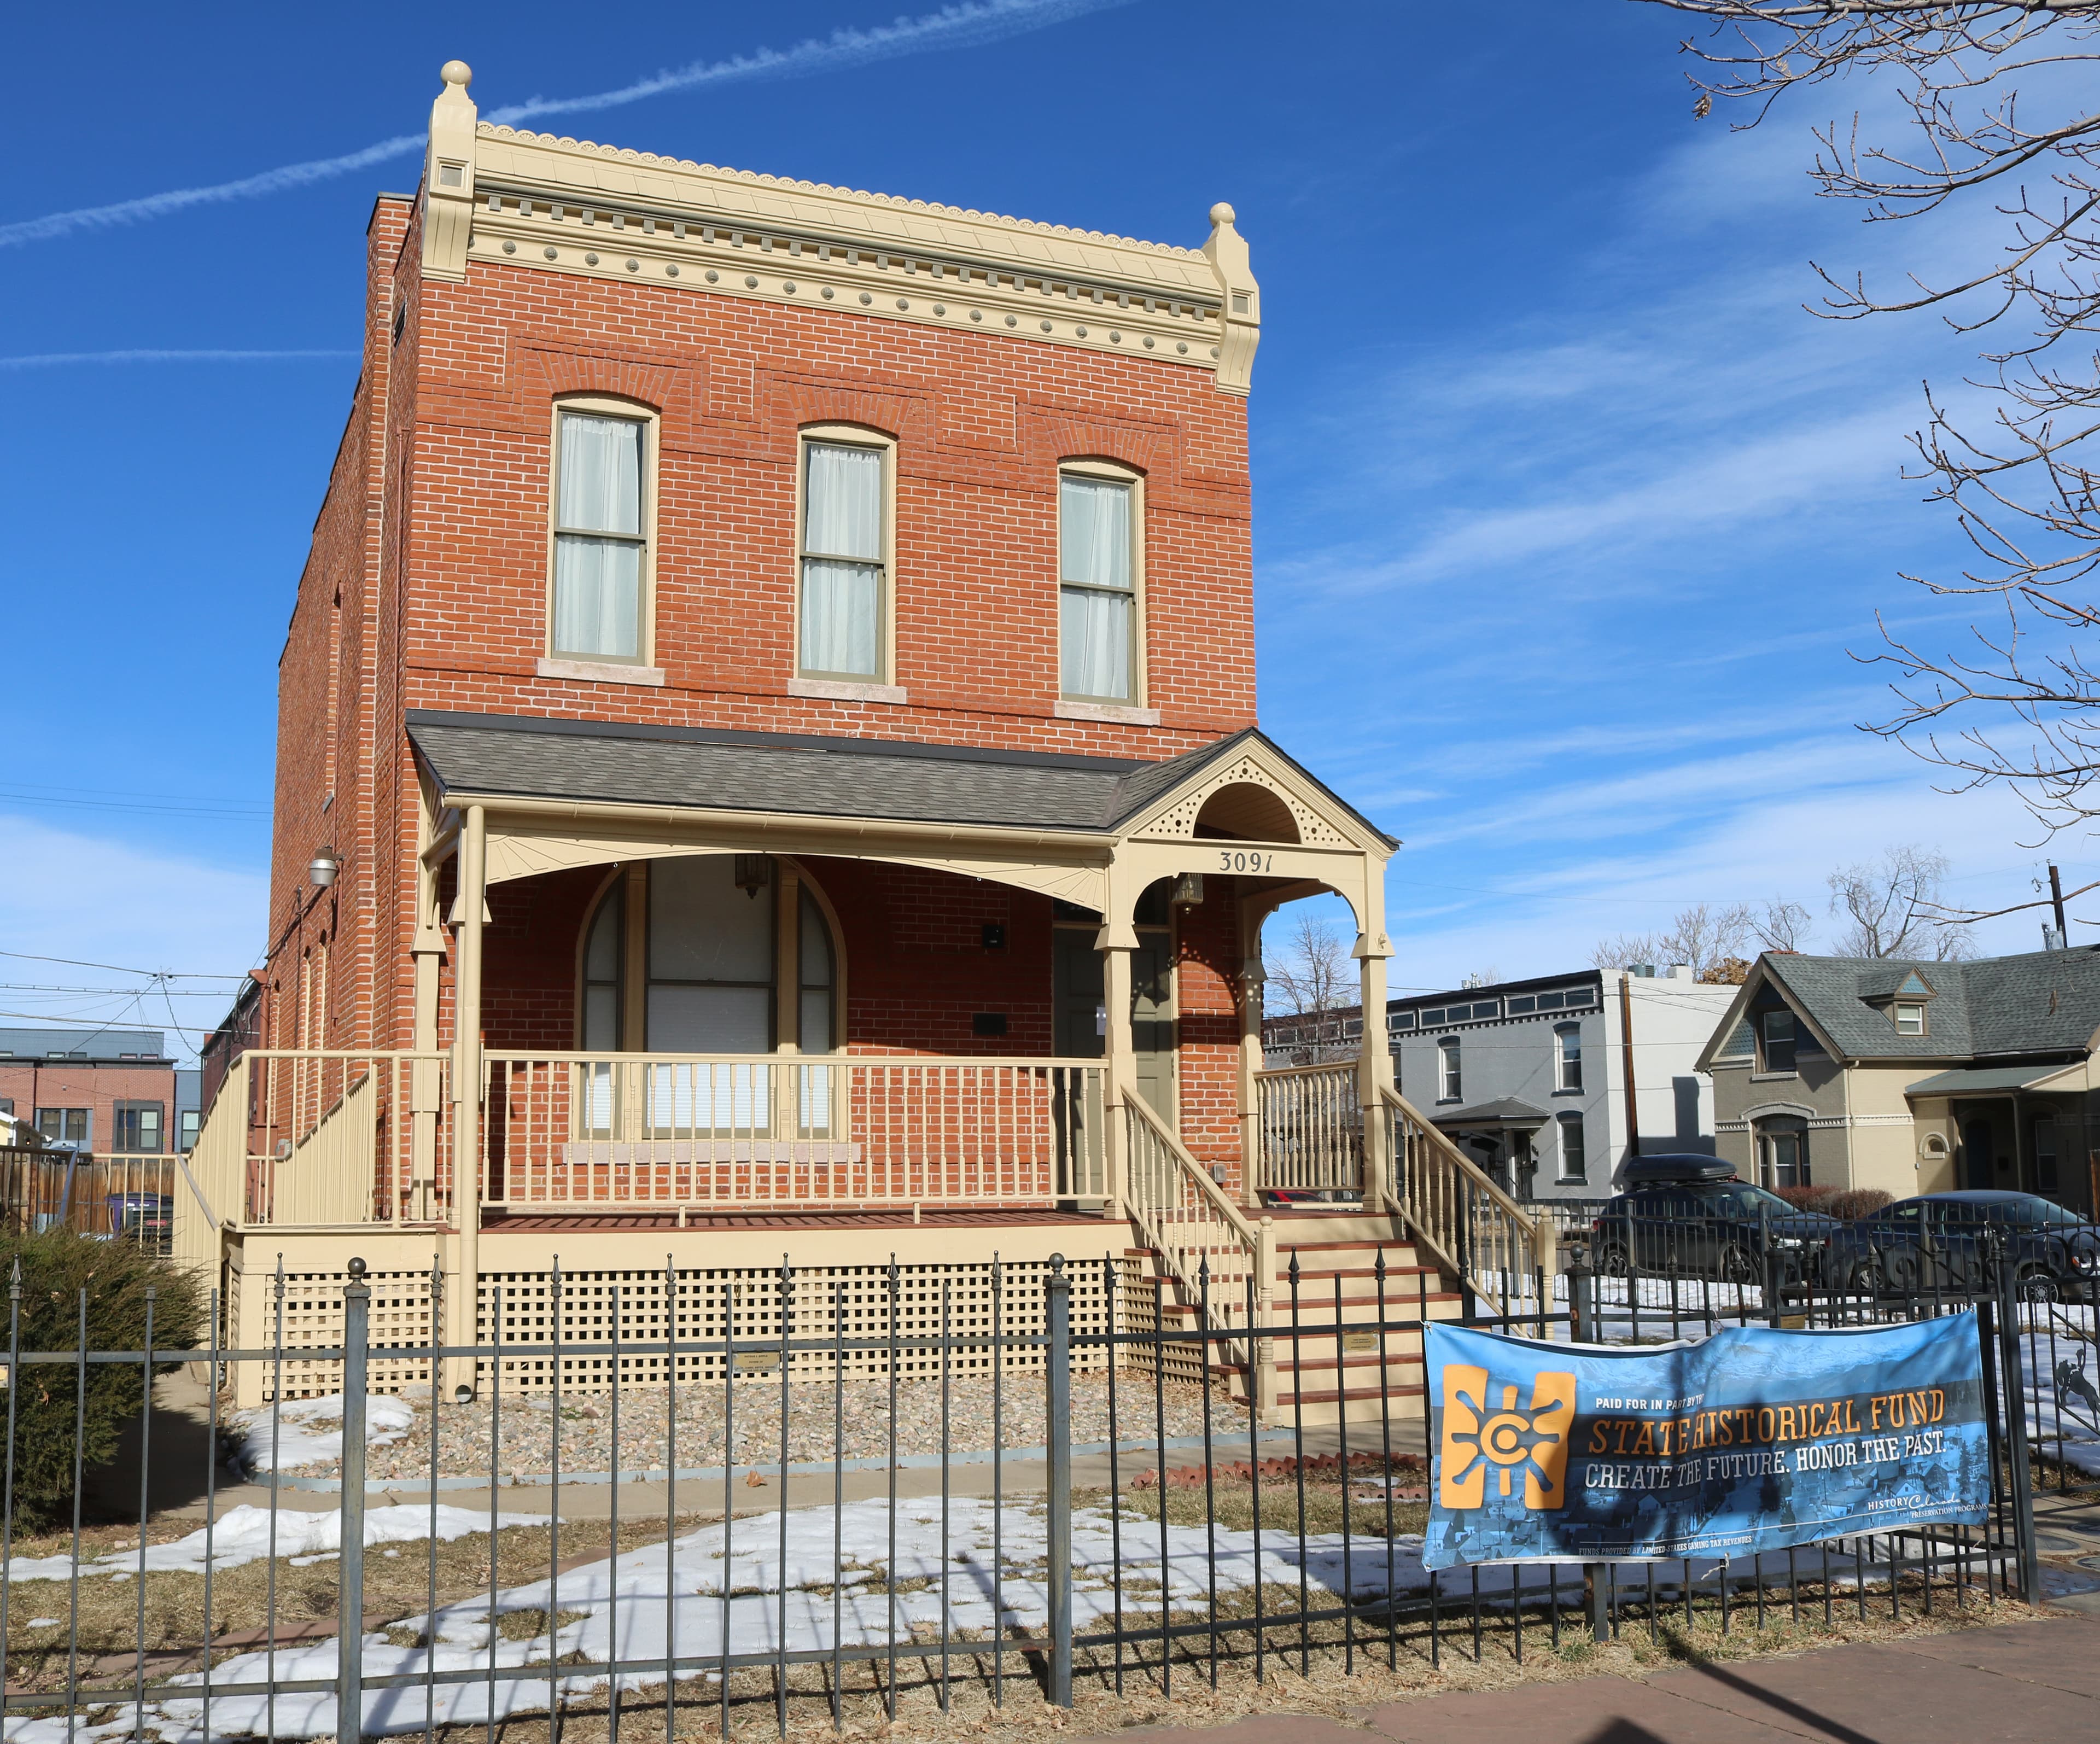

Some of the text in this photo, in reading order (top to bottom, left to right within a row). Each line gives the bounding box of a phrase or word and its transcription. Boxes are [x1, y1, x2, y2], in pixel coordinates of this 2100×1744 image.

[1220, 851, 1272, 873] 3091
[1596, 1397, 1622, 1409] PAID
[1625, 1398, 1647, 1410] FOR
[1651, 1399, 1662, 1410] IN
[1666, 1398, 1686, 1410] PART
[1687, 1395, 1695, 1407] BY
[1589, 1389, 1945, 1456] STATE HISTORICAL FUND
[1585, 1430, 1946, 1489] CREATE THE FUTURE. HONOR THE PAST.
[1868, 1492, 1961, 1510] HISTORY Colorado
[1911, 1503, 1987, 1519] PRESERVATION PROGRAMS
[1641, 1543, 1687, 1554] LIMITED-STAKES
[1688, 1540, 1709, 1550] GAMING
[1710, 1539, 1722, 1548] TAX
[1723, 1535, 1752, 1547] REVENUES
